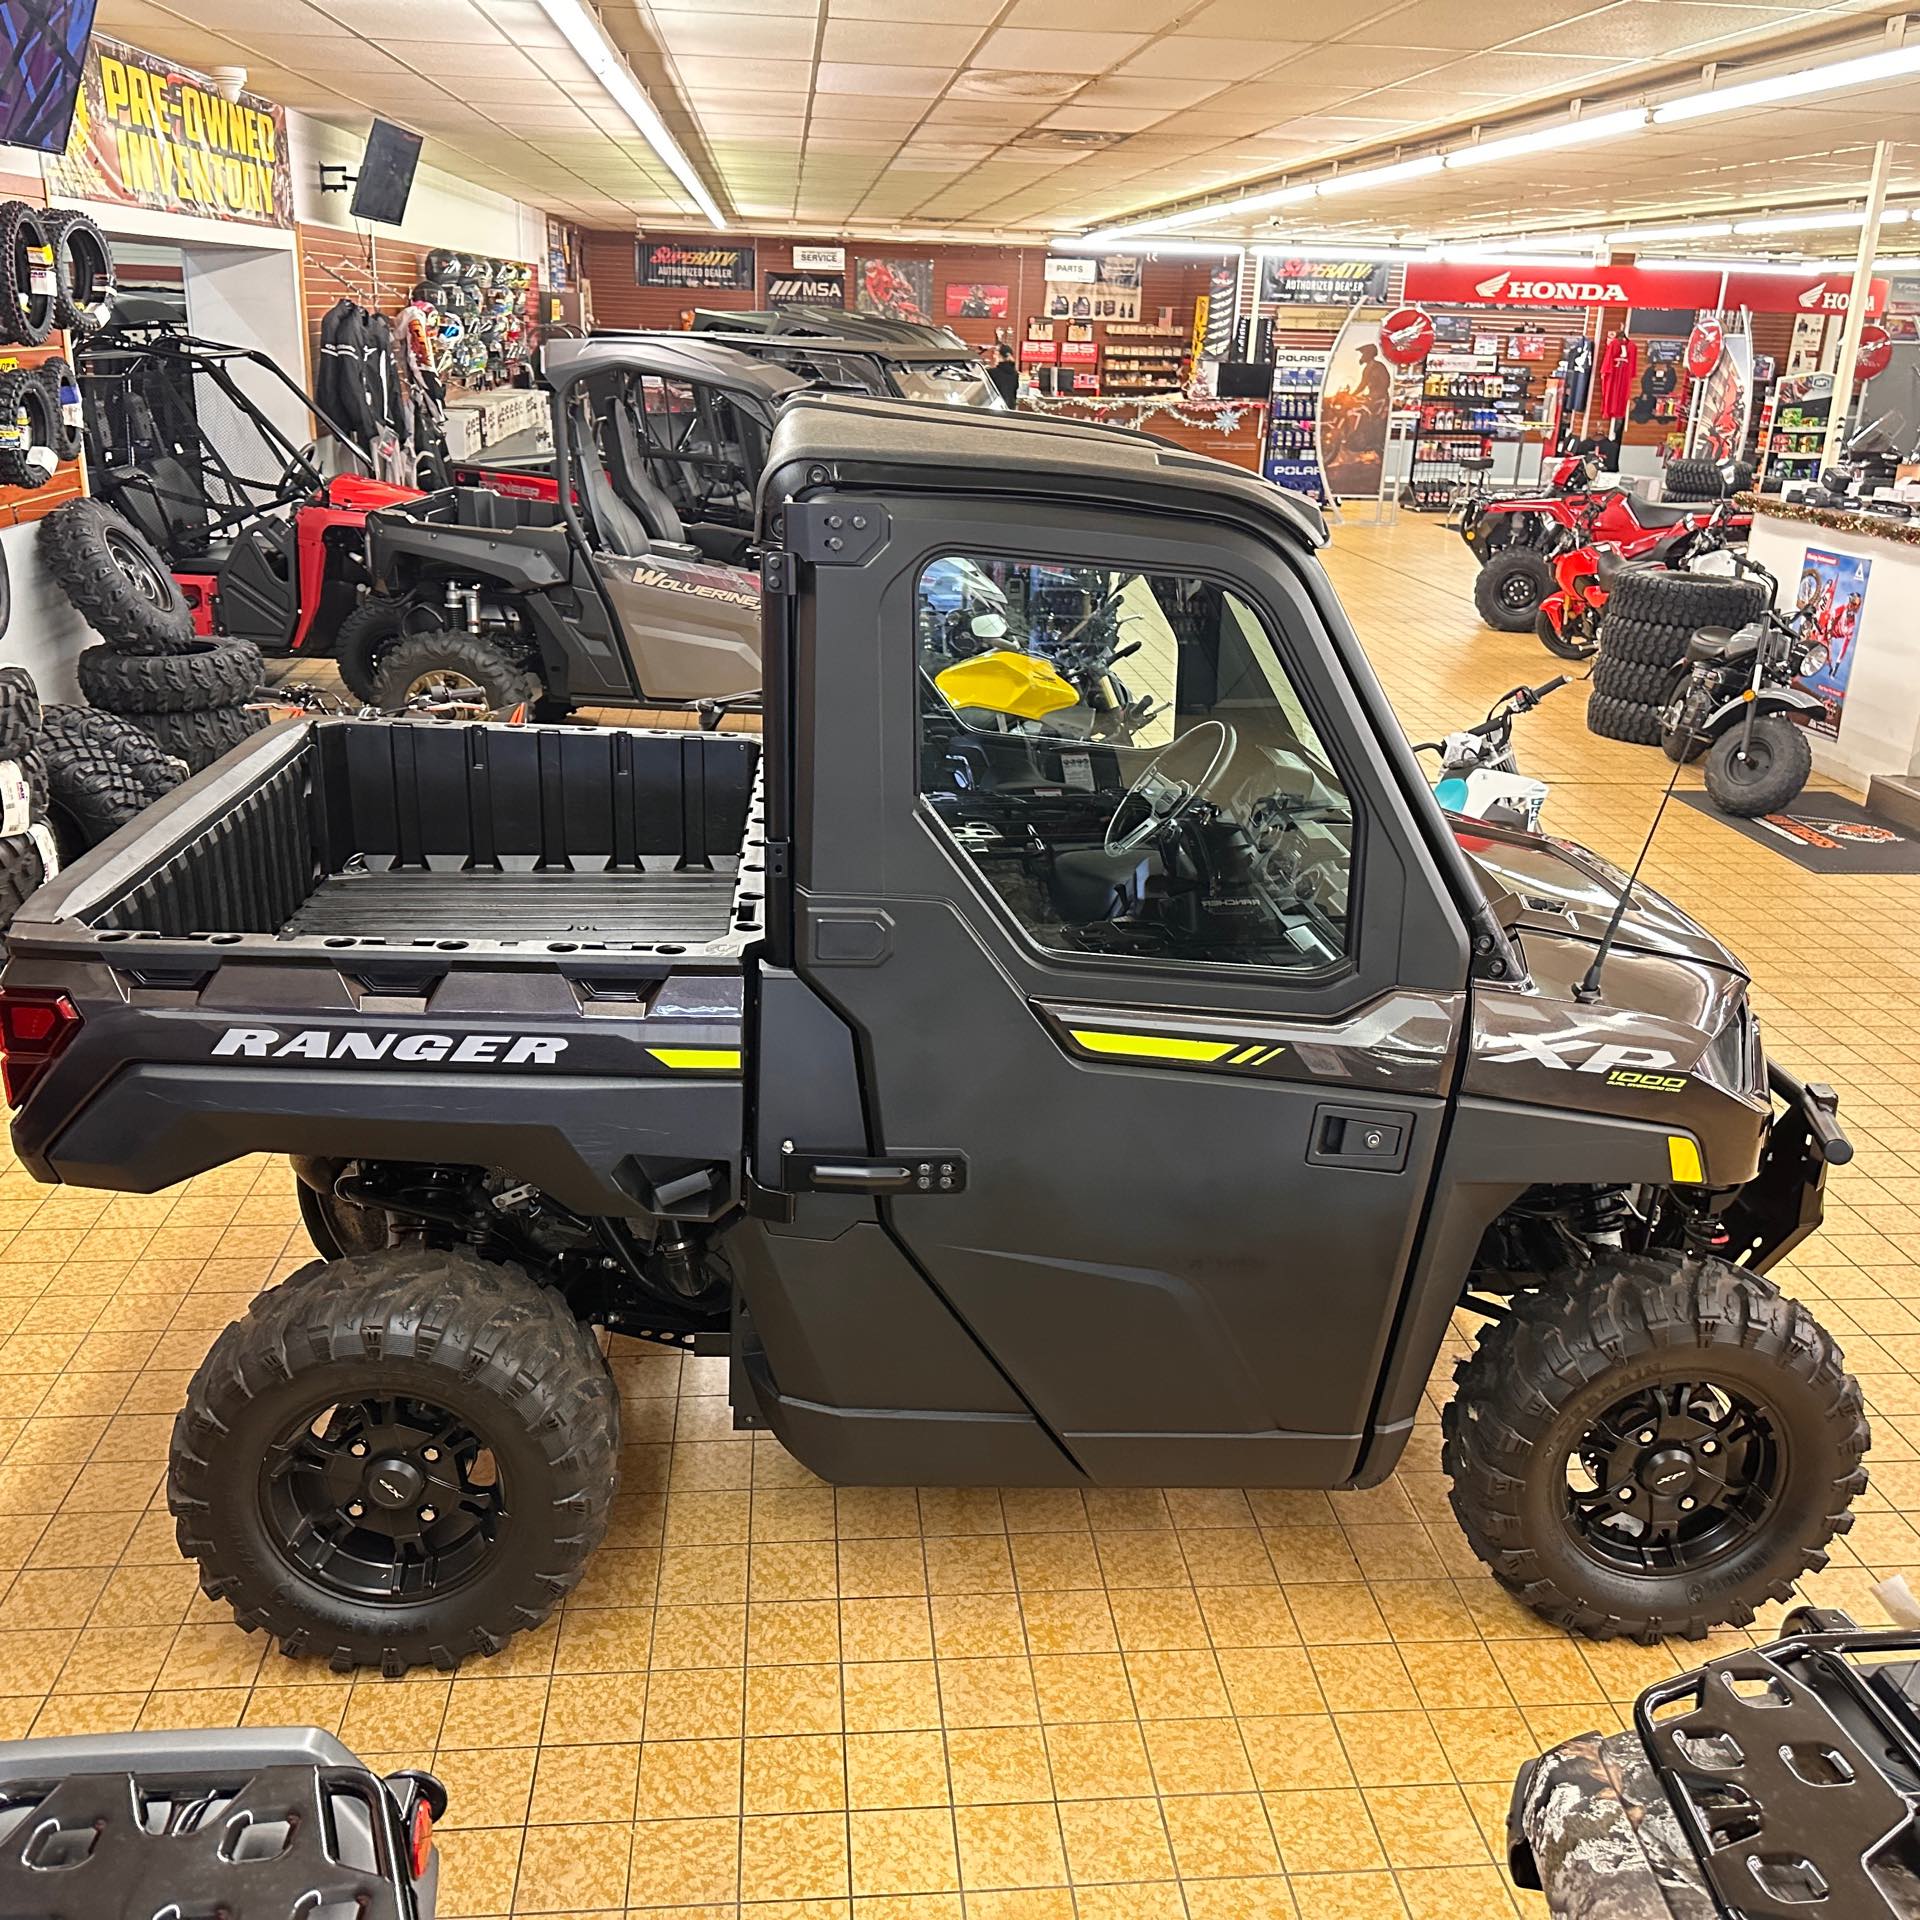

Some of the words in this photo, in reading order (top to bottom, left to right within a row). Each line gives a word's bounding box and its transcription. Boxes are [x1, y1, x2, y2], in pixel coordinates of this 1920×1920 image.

[100, 56, 276, 163] PRE-OWNED
[116, 127, 274, 215] INVENTORY
[801, 253, 838, 262] SERVICE
[658, 266, 702, 277] AUTHORIZED
[704, 268, 732, 278] DEALER
[1056, 264, 1083, 273] PARTS
[802, 281, 842, 297] MSA
[1285, 280, 1334, 291] AUTHORIZED
[1507, 281, 1629, 301] HONDA
[1821, 292, 1875, 312] HOA
[1022, 342, 1056, 353] BS
[1061, 343, 1096, 354] BS
[1278, 354, 1326, 363] POLARIS
[1273, 465, 1320, 476] POLAR
[631, 566, 759, 608] WOLVERINE
[211, 1028, 568, 1065] RANGER
[1478, 1031, 1677, 1074] XP
[1608, 1070, 1688, 1089] 1000
